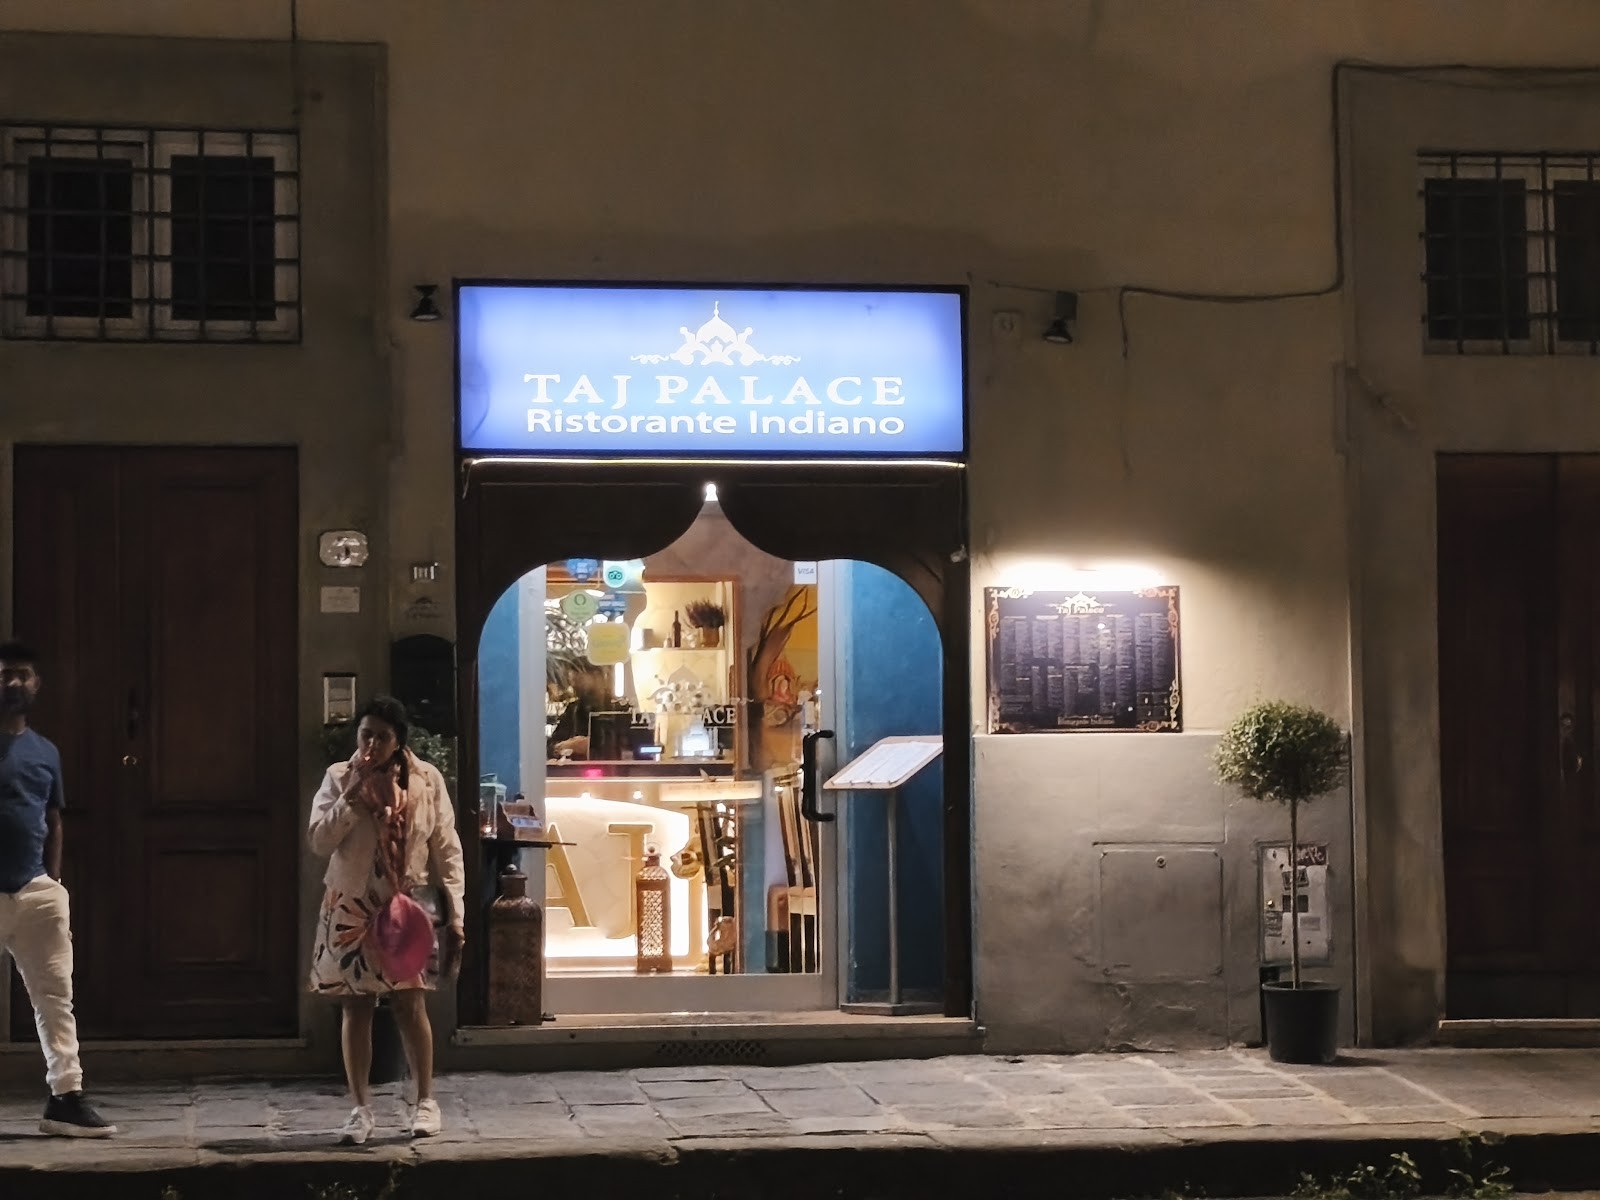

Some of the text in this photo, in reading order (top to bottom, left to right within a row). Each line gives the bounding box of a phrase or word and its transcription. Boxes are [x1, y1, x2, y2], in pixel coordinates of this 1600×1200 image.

[524, 373, 906, 410] TAJ PALACE
[527, 408, 905, 435] Ristorante Indiano
[797, 567, 815, 575] VISA
